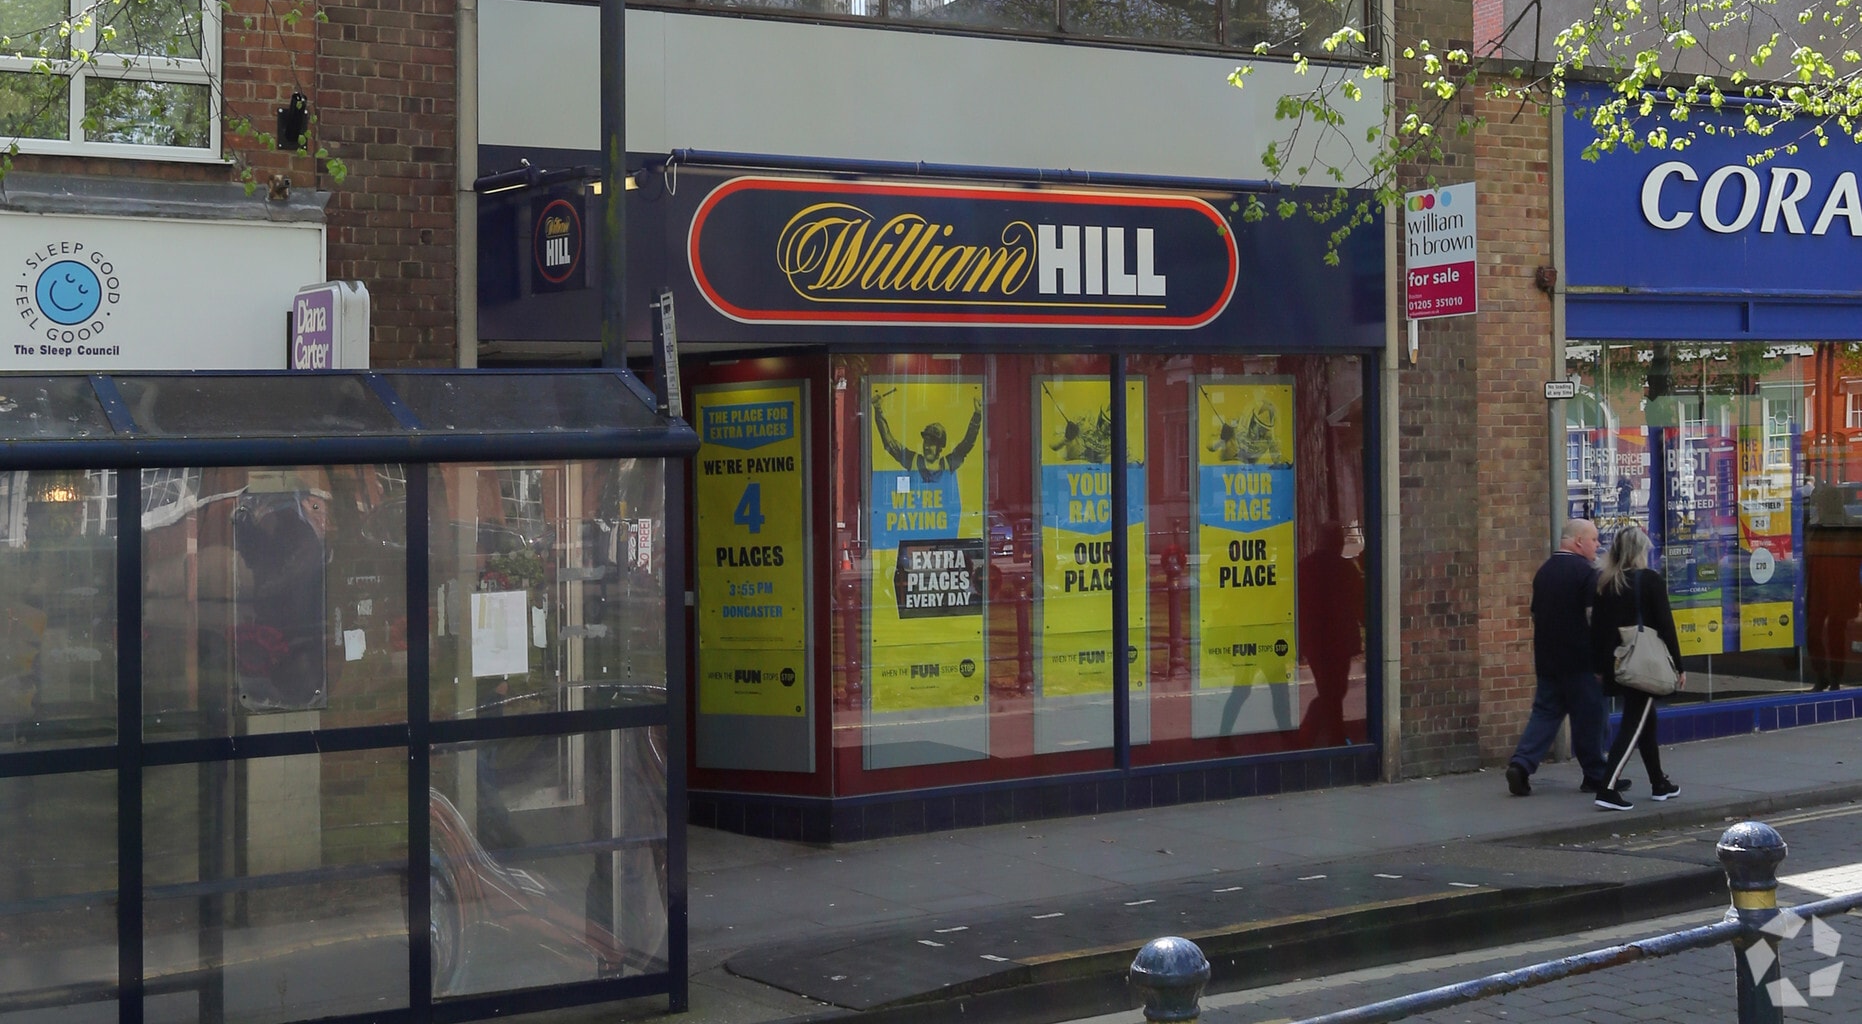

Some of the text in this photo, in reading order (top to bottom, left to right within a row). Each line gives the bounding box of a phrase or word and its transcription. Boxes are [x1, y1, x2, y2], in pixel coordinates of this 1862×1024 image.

[1641, 161, 1862, 236] CORA
[1408, 213, 1463, 235] william
[546, 237, 571, 266] HILL
[776, 202, 1167, 297] William HILL
[1410, 234, 1474, 257] h brown
[25, 241, 120, 304] SLEEP GOOD
[1408, 268, 1460, 287] for sale
[15, 284, 105, 343] FEEL GOOD
[1409, 296, 1463, 311] 01205 351010
[297, 299, 327, 334] Diana
[14, 345, 120, 357] The Sleep Council
[295, 335, 329, 370] Carter
[709, 407, 788, 424] THE PLACE FOR
[710, 423, 787, 439] EXTRA PLACES
[704, 456, 795, 475] WE'RE PAYING
[1067, 472, 1112, 496] YOU
[1223, 472, 1272, 496] YOUR
[733, 482, 765, 534] 4
[891, 489, 943, 509] WE'RE
[1223, 498, 1272, 522] RACE
[886, 511, 947, 531] PAYING
[1069, 499, 1112, 524] RAC
[716, 545, 784, 567] PLACES
[912, 550, 966, 570] EXTRA
[1228, 539, 1266, 562] OUR
[907, 571, 970, 592] PLACES
[1065, 568, 1112, 592] PLAC
[1219, 564, 1277, 589] PLACE
[729, 582, 773, 596] 3:55 PM
[906, 591, 971, 608] EVERY DAY
[722, 605, 783, 618] DONCASTER
[1079, 650, 1105, 664] FUN
[1232, 643, 1257, 656] FUN
[1275, 644, 1288, 652] STOP
[735, 669, 762, 684] FUN
[781, 673, 794, 682] STOP
[910, 663, 939, 679] FUN
[941, 665, 958, 674] STOPS
[960, 664, 974, 673] STOP
